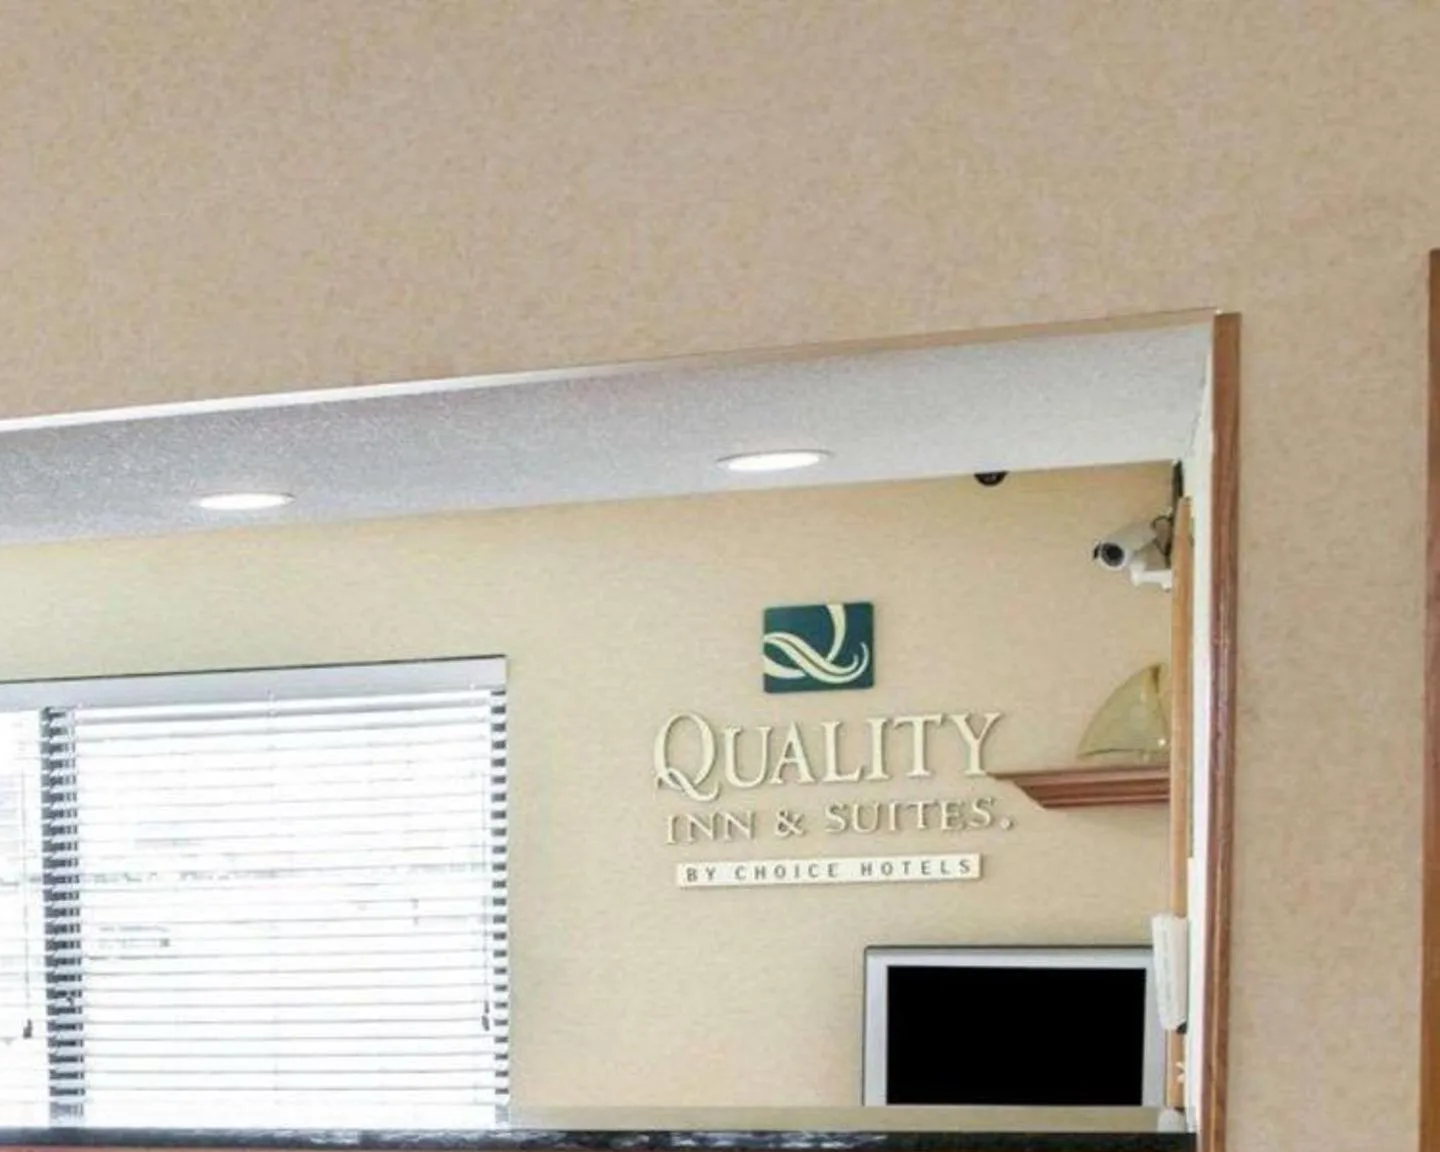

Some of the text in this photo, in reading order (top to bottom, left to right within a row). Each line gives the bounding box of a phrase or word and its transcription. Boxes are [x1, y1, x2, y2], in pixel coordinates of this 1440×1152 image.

[654, 711, 1002, 801] QUALITY
[665, 810, 756, 845] INN
[773, 808, 806, 838] &
[685, 858, 972, 882] BY CHOICE HOTELS
